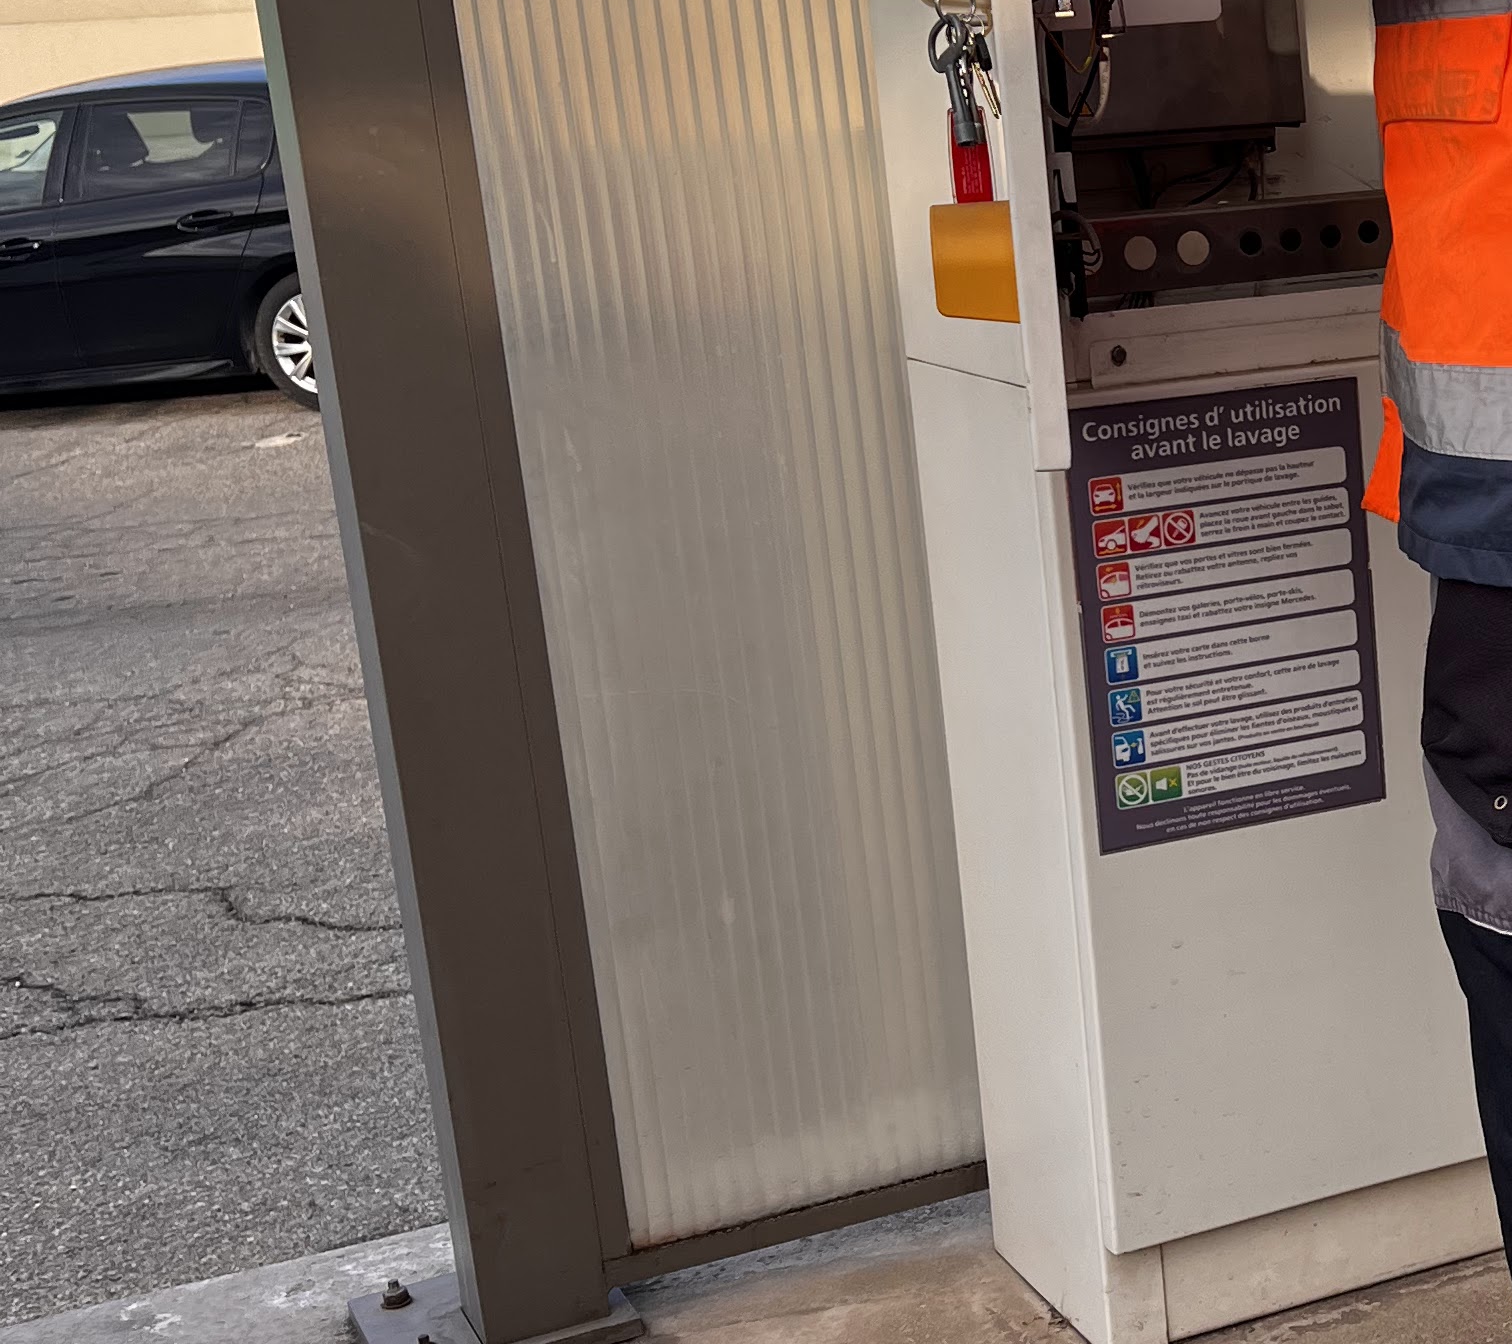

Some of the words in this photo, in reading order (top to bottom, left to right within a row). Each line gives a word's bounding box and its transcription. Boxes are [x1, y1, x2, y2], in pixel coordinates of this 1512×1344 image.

[1082, 412, 1200, 443] Consignes
[1230, 395, 1341, 424] utilisation
[1131, 433, 1197, 460] avant
[1202, 430, 1222, 451] le
[1227, 423, 1300, 453] lavage
[1186, 762, 1202, 771] NOS
[1203, 757, 1229, 768] GESTES
[1231, 751, 1265, 763] CITOYENS
